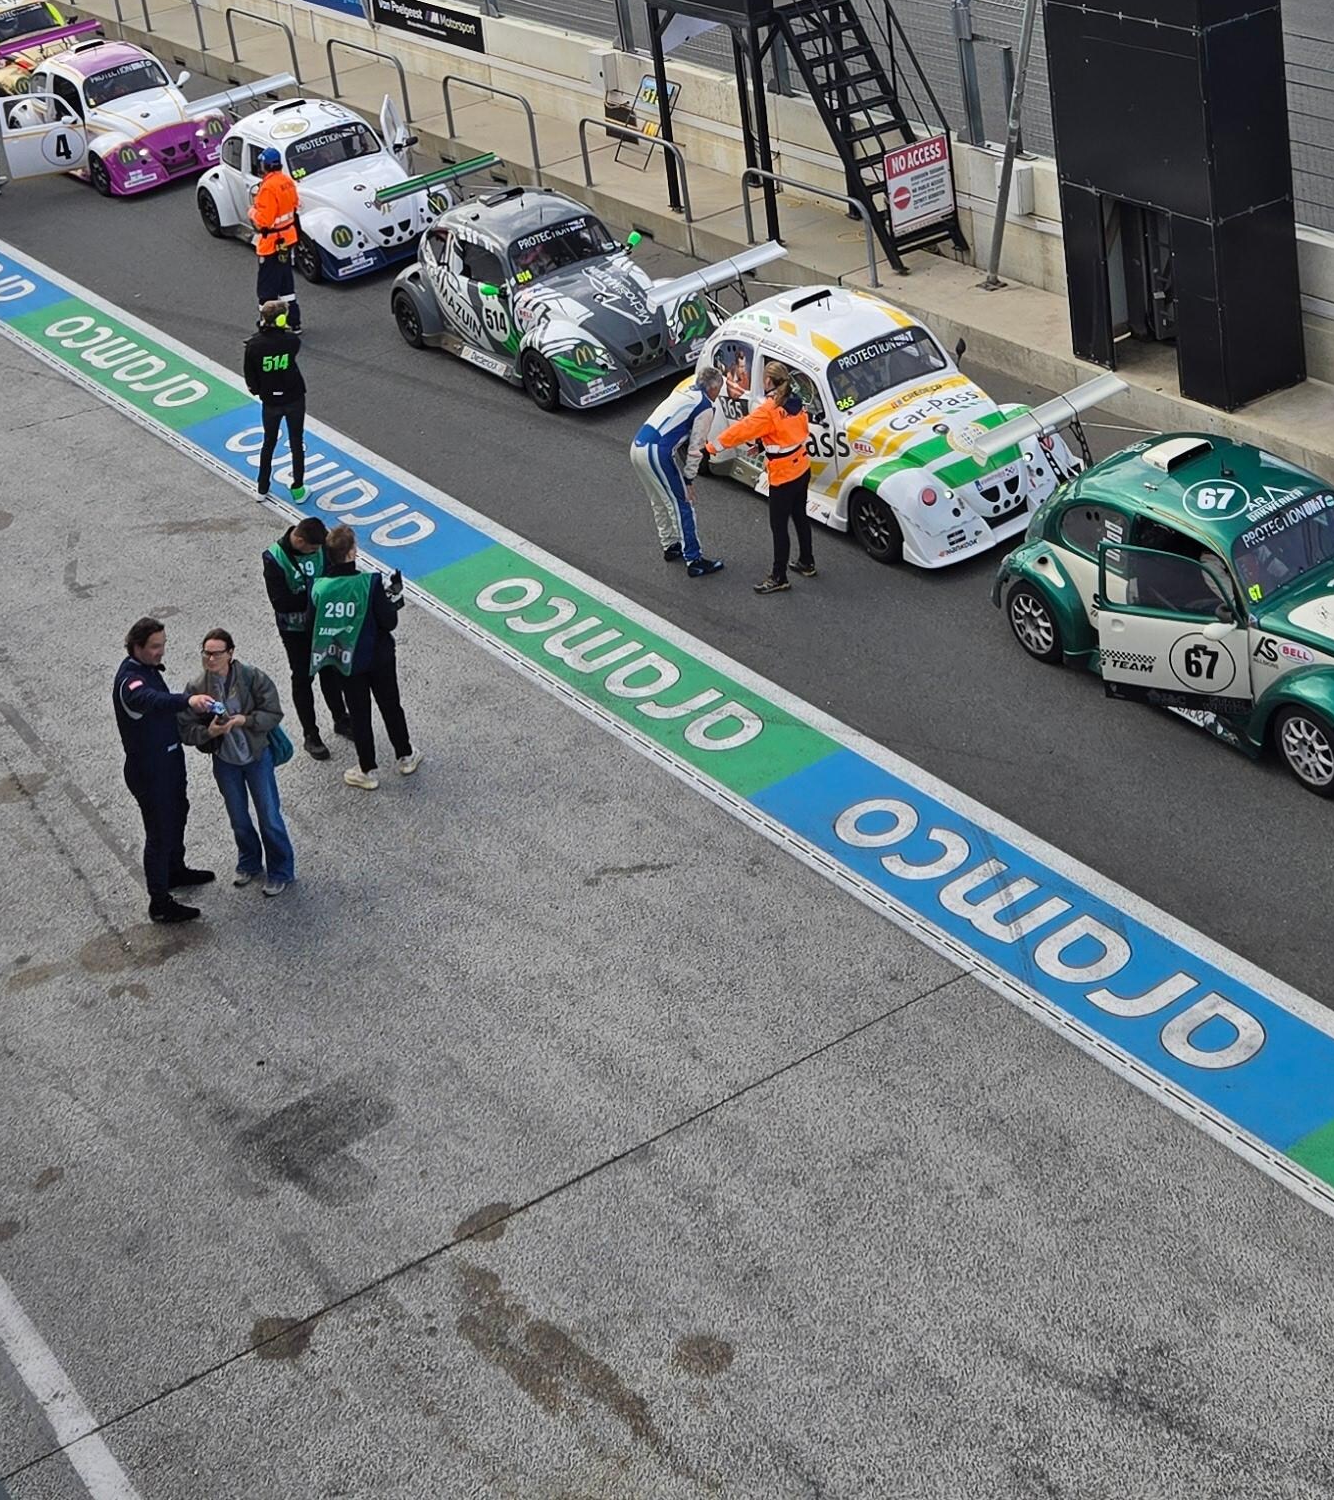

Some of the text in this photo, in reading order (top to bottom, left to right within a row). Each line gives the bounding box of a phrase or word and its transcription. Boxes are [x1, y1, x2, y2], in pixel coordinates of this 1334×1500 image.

[391, 0, 423, 20] Poelgeest
[439, 13, 476, 36] Motorsport
[56, 134, 72, 160] 4
[891, 155, 906, 174] NO
[907, 142, 942, 169] ACCESS
[485, 307, 507, 335] 514
[45, 315, 210, 408] aramco
[262, 353, 289, 373] 514
[722, 397, 744, 420] 365
[836, 396, 855, 411] 365
[889, 390, 979, 432] Car-Pass
[1197, 487, 1236, 511] 67
[1248, 584, 1263, 602] 67
[325, 601, 355, 618] 290
[475, 577, 764, 752] aramco
[1112, 659, 1154, 673] TEAM
[1184, 646, 1219, 680] 67
[1282, 645, 1309, 661] BELL
[832, 796, 1267, 1070] aramco
